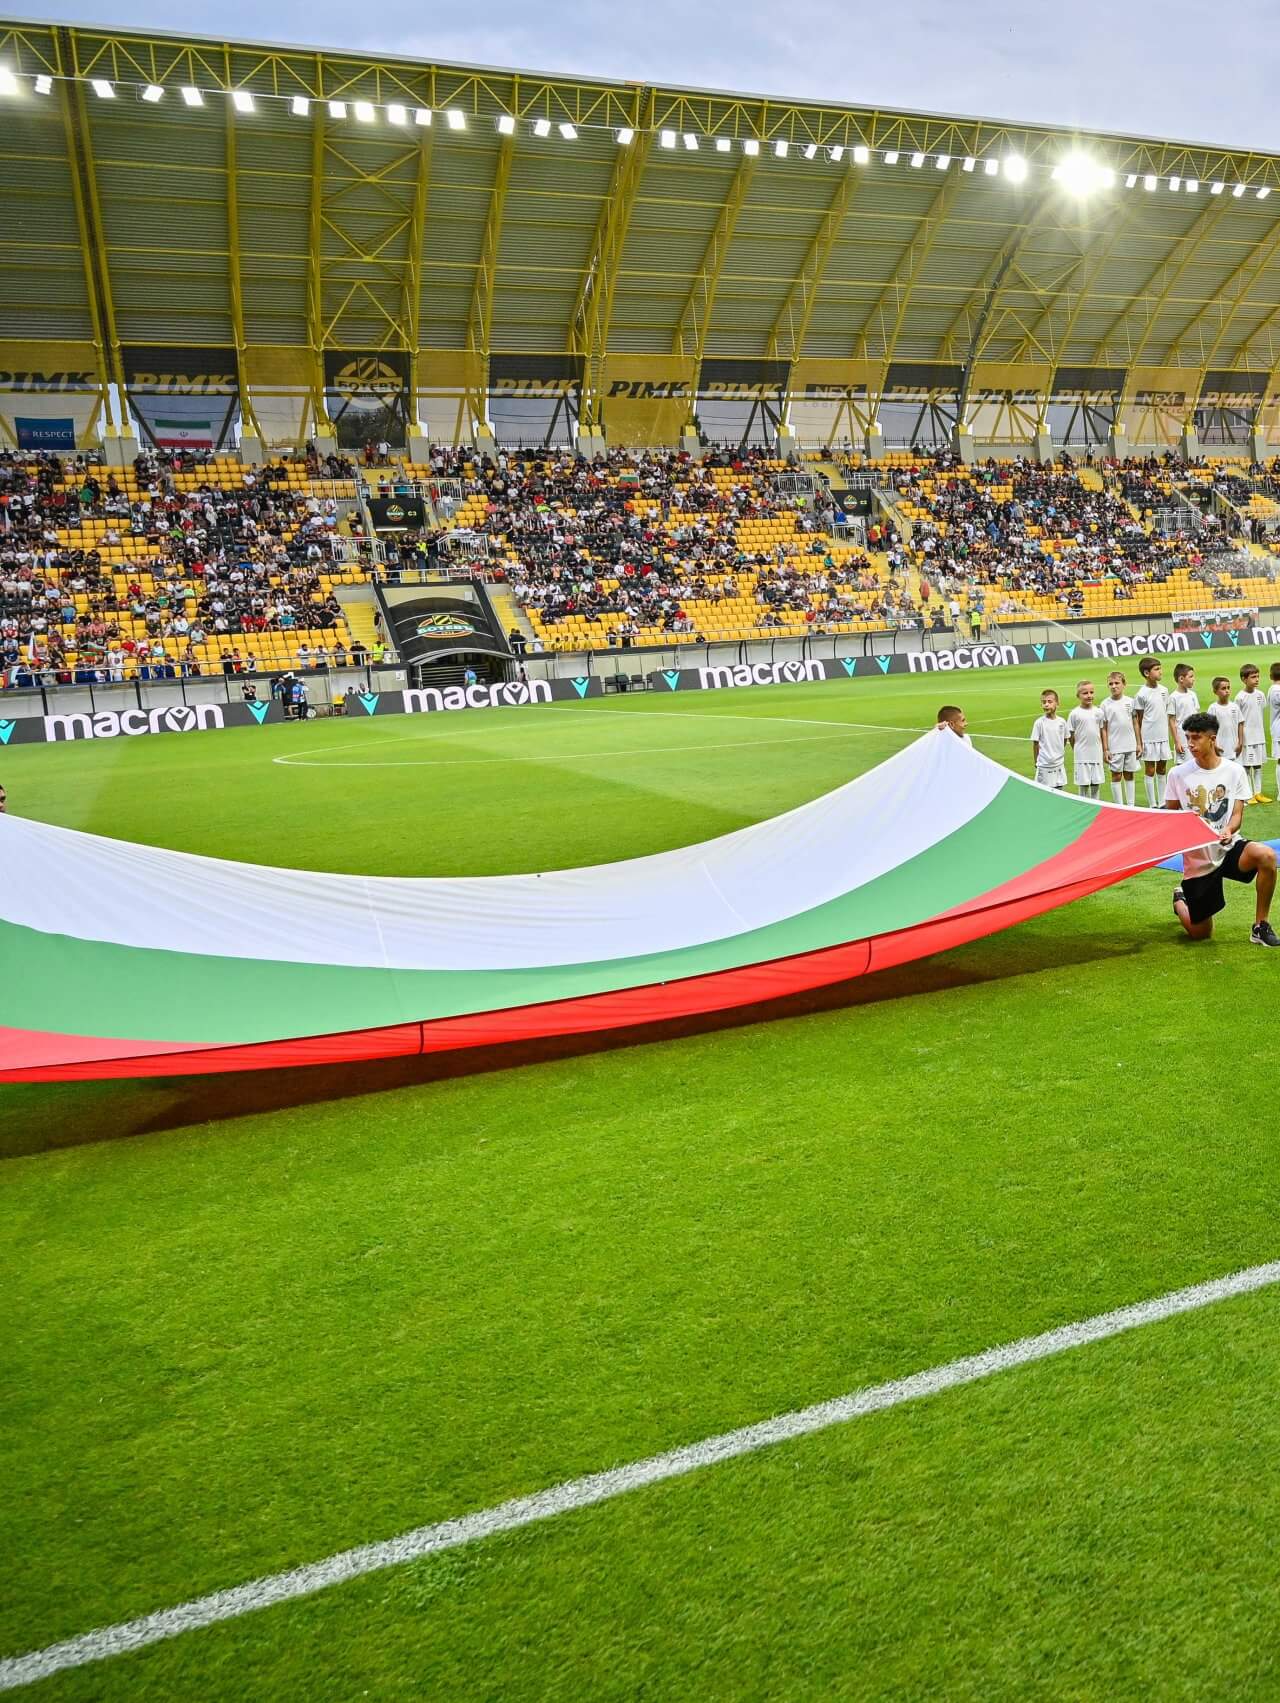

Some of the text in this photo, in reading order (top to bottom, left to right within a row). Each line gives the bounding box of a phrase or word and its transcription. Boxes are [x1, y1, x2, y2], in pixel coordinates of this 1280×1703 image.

[129, 373, 236, 394] PIMK
[495, 378, 579, 398] PIMK
[606, 380, 690, 399] PIMK
[705, 382, 783, 400] PIMK
[815, 385, 858, 399] NEXT
[1054, 389, 1120, 406] PIMK
[1142, 391, 1181, 405] NEXT
[907, 645, 1020, 673] macron
[699, 659, 827, 690] macron
[402, 680, 553, 714] macron
[44, 704, 225, 742] macron
